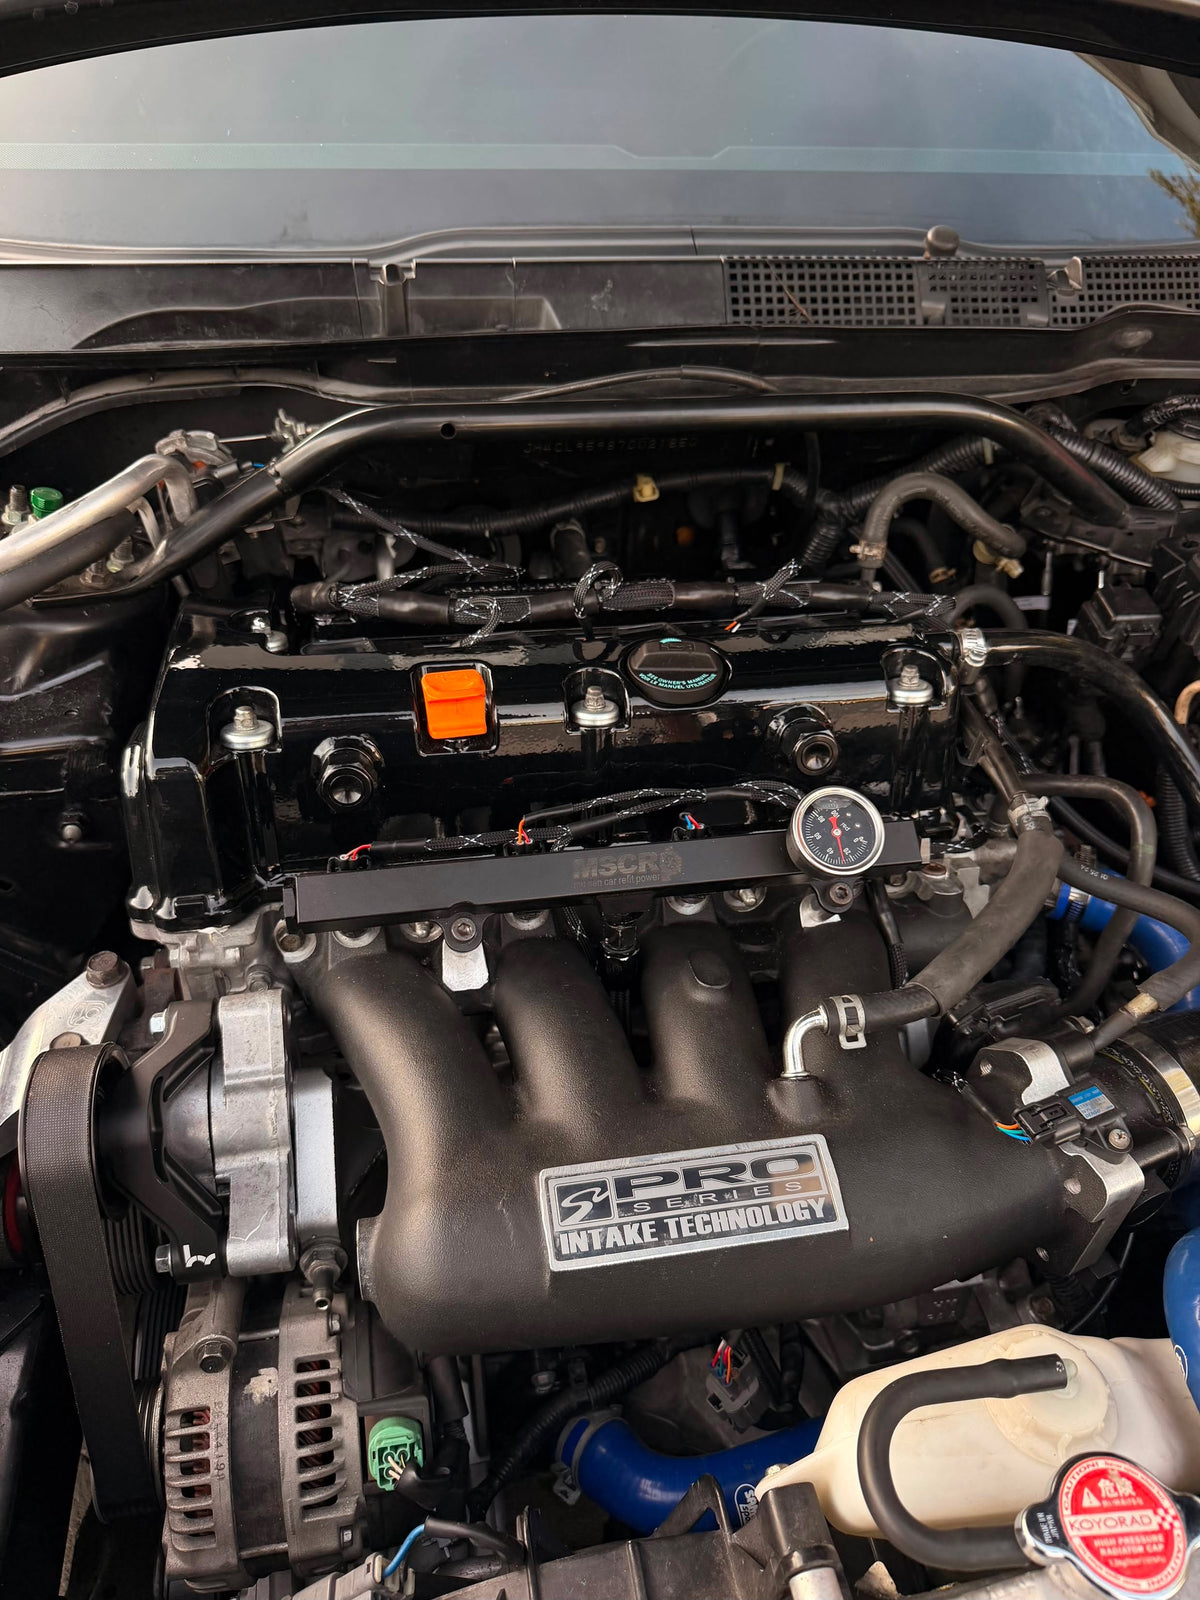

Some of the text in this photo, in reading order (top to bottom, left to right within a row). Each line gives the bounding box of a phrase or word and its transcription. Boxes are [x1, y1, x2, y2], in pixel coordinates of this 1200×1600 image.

[658, 682, 685, 690] MANUEL
[636, 874, 660, 885] power
[613, 1152, 816, 1200] PRO
[633, 1181, 803, 1213] SERIES
[559, 1197, 826, 1254] INTAKE TECHNOLOGY
[1063, 1461, 1099, 1511] CAUTION!
[1068, 1514, 1153, 1532] KOYORAD
[1093, 1534, 1164, 1549] HIGH PRESSURE
[1100, 1543, 1165, 1557] RADIATOR CAP
